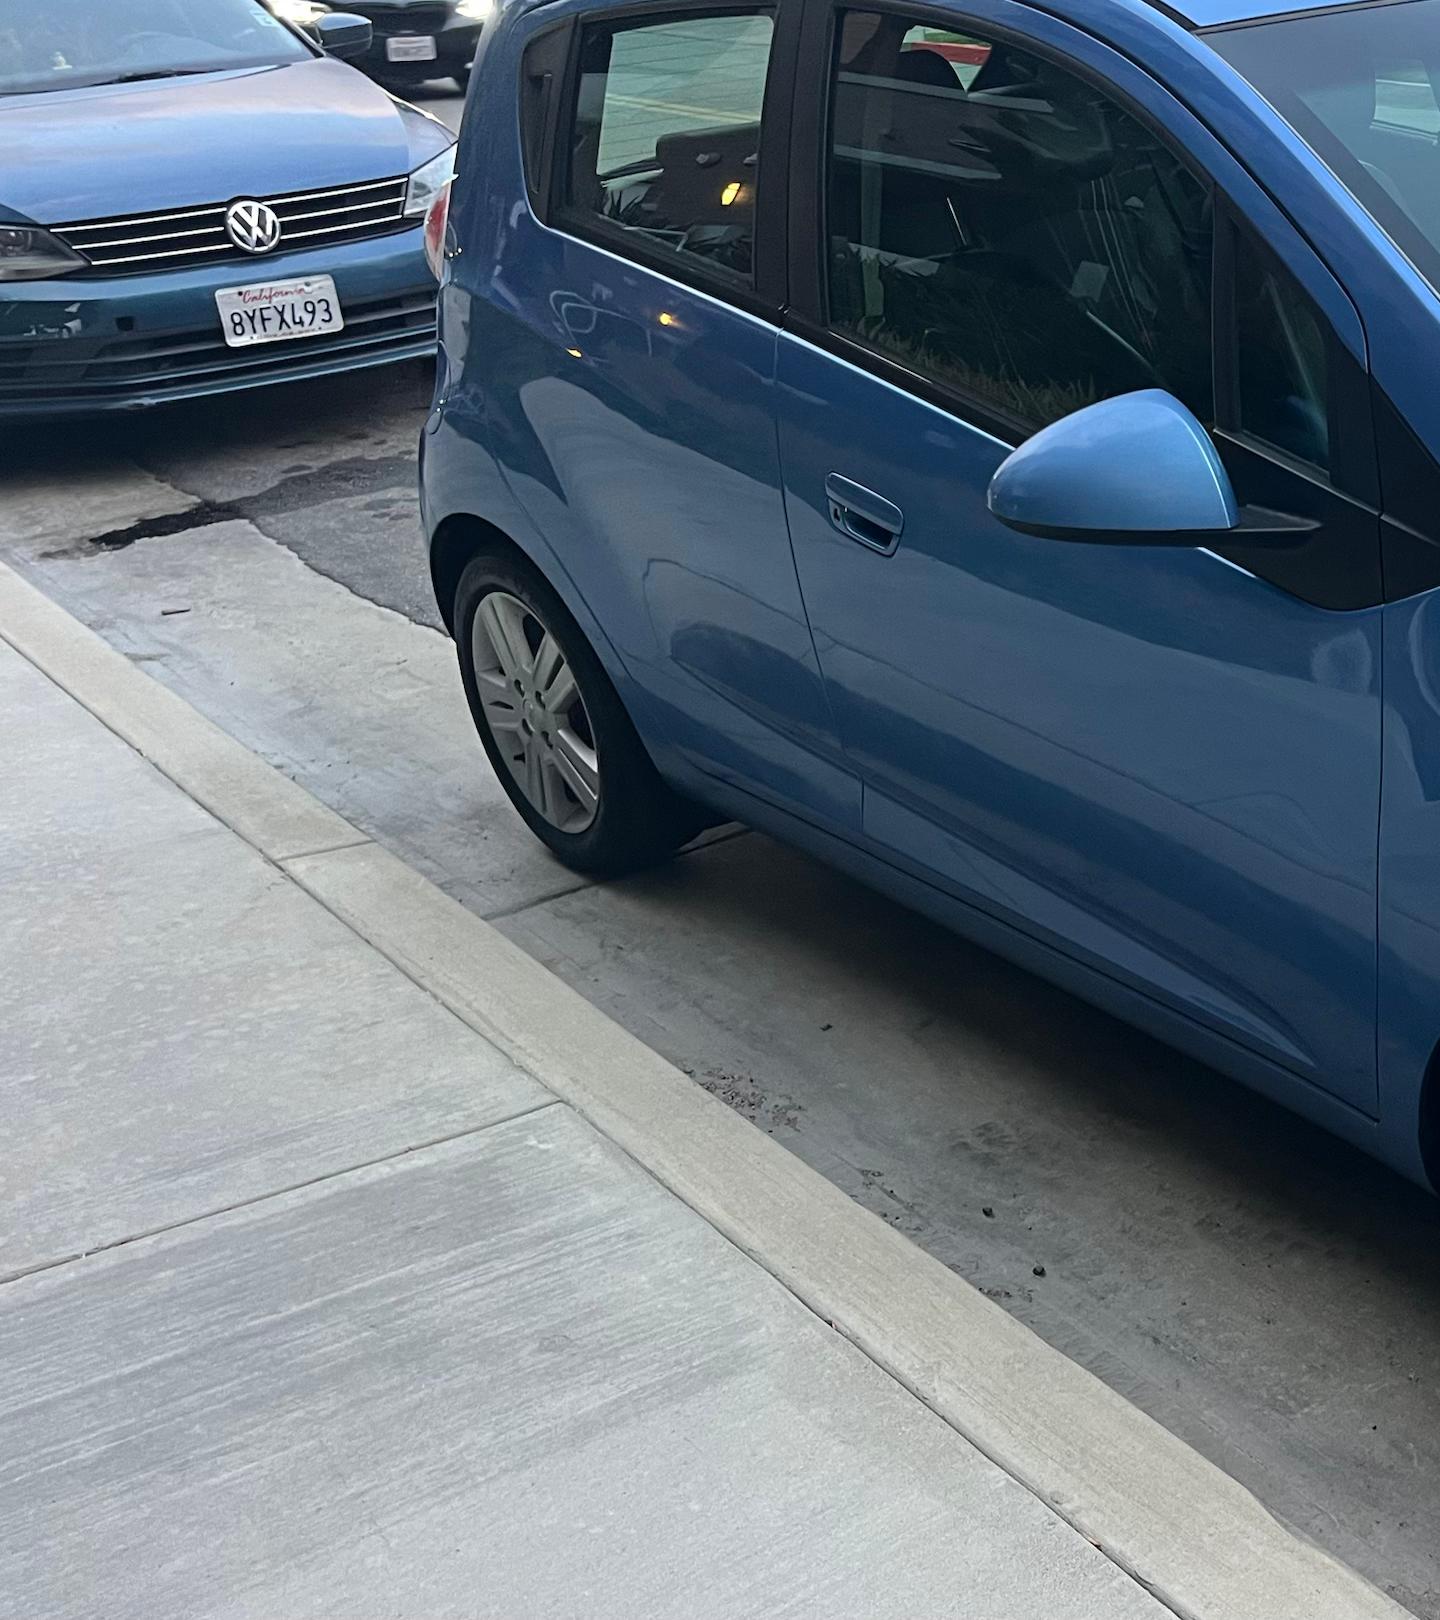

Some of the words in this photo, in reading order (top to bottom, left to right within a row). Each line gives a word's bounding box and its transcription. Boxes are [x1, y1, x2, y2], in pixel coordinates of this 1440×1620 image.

[228, 202, 279, 251] VW
[243, 286, 306, 304] California
[230, 298, 333, 337] 8YFX493
